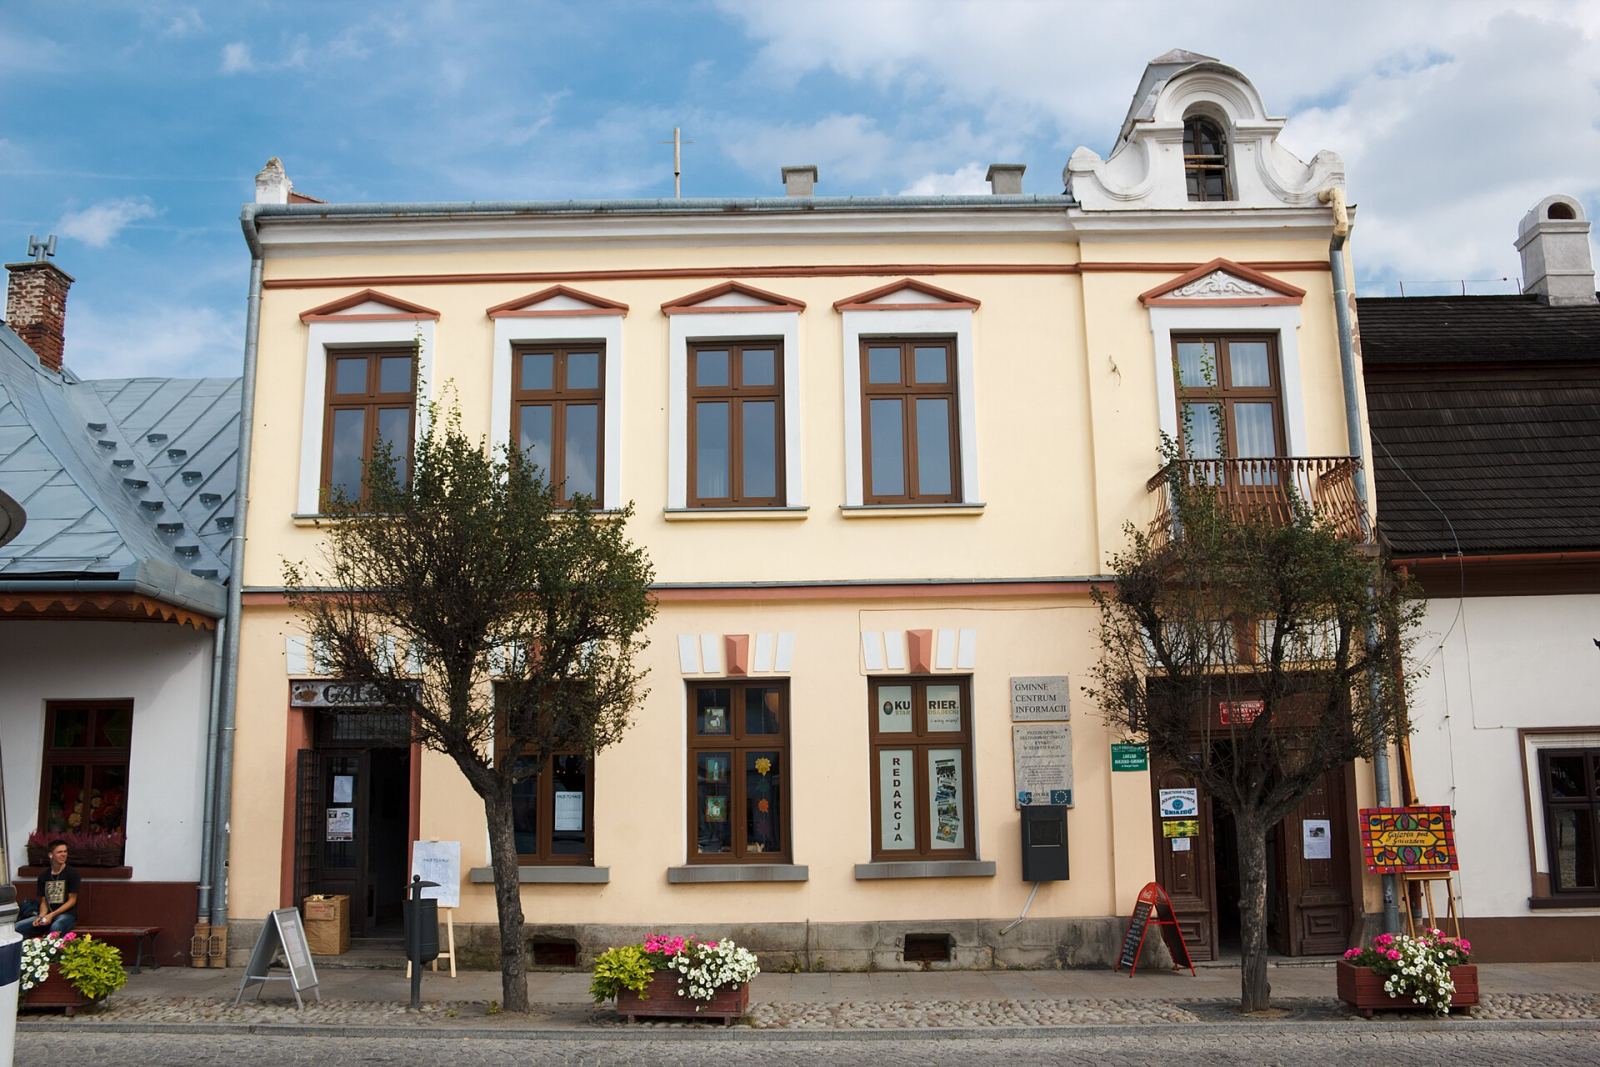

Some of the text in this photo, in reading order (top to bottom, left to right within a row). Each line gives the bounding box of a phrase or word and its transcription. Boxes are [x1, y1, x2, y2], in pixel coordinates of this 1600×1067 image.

[1014, 683, 1049, 691] GMINNE
[1015, 694, 1057, 702] CENTRUM
[894, 700, 911, 710] KU
[1015, 705, 1067, 713] INFORMACJI
[892, 757, 903, 842] REDAKCJA
